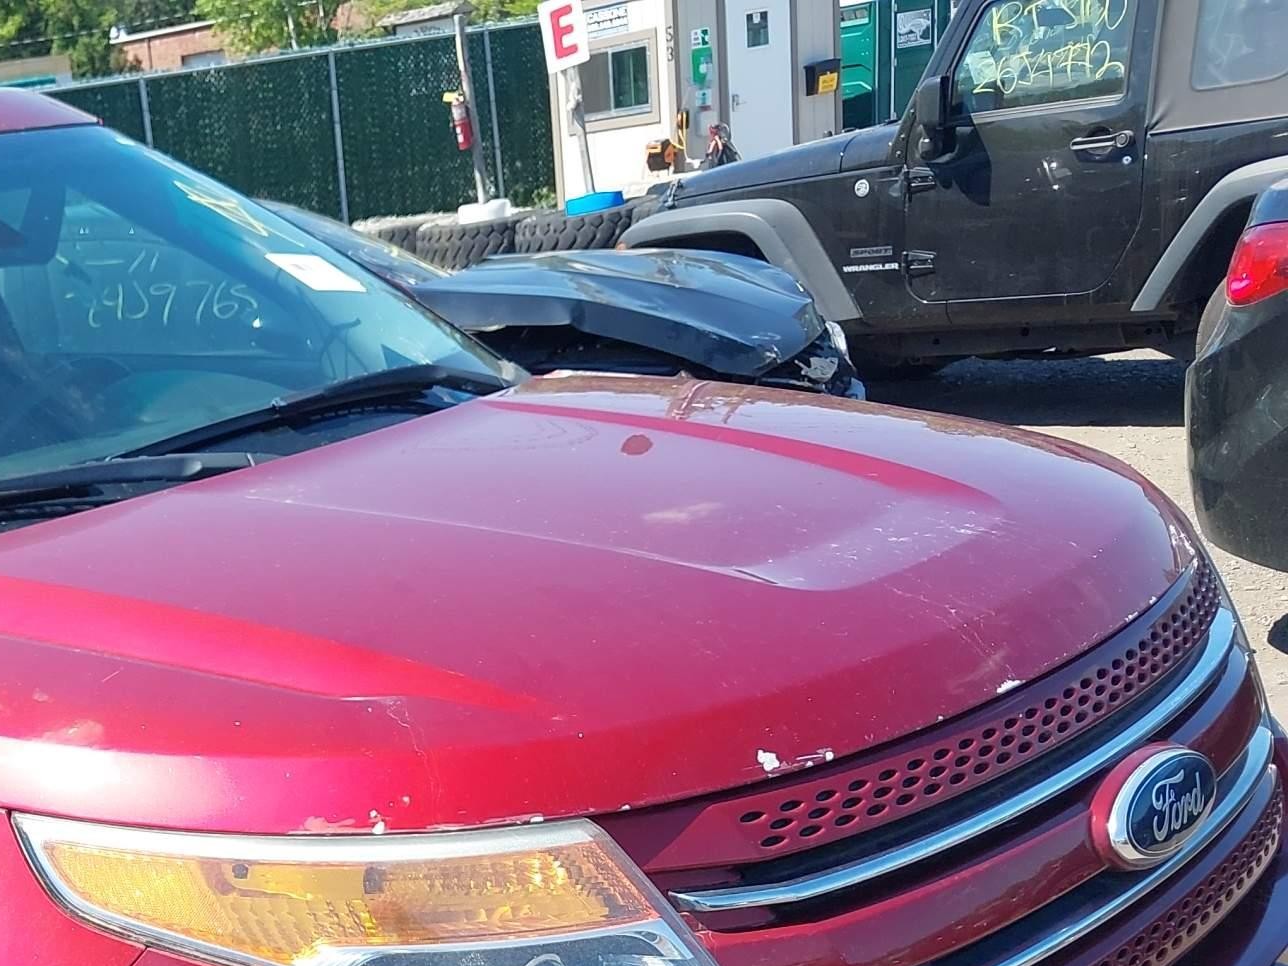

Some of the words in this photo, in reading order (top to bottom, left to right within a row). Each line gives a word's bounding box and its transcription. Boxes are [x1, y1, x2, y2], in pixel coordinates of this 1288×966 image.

[550, 4, 578, 59] E
[842, 262, 899, 273] WRANGLER
[1151, 768, 1205, 843] Ford
